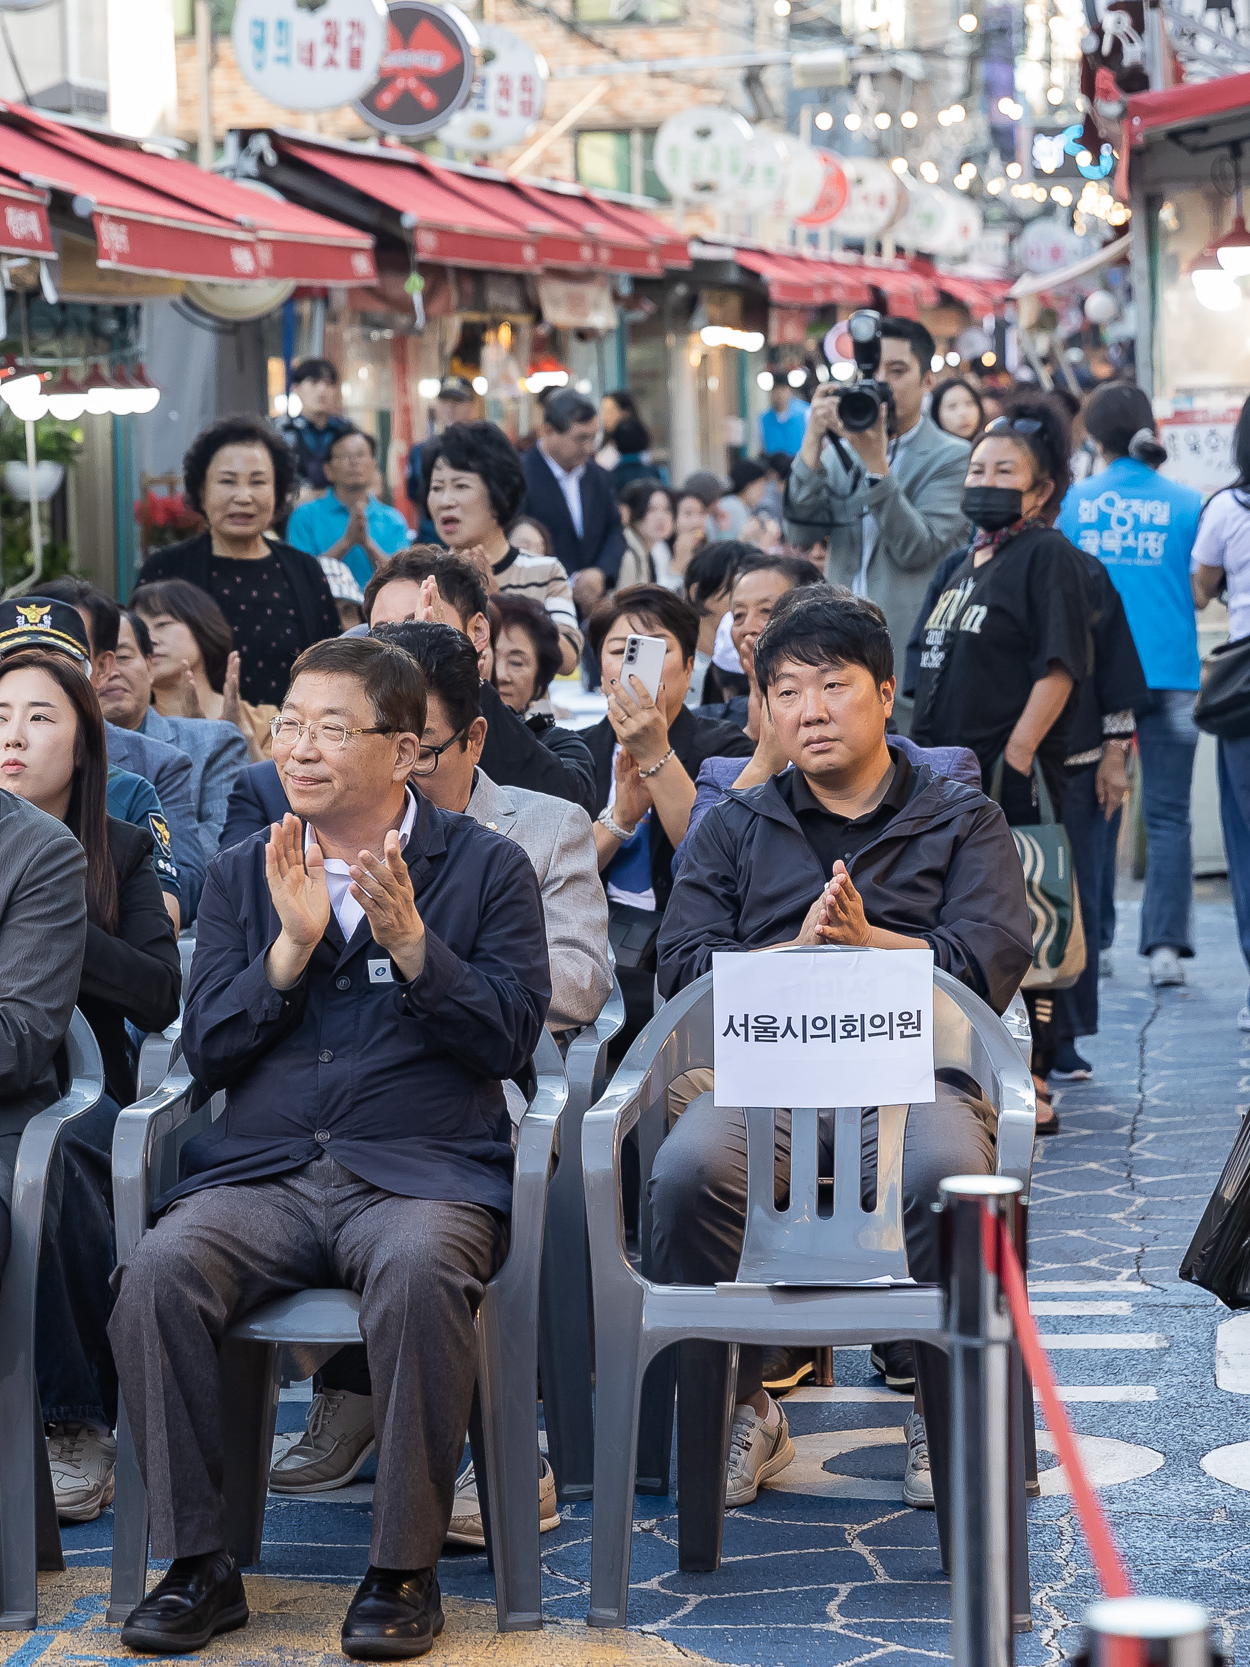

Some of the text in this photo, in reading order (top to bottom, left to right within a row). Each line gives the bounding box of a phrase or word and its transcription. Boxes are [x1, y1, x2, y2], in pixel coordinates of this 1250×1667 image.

[1078, 490, 1171, 533] 화양제일
[1078, 529, 1168, 558] 골목시장
[722, 1010, 922, 1043] 서울시의회의원
